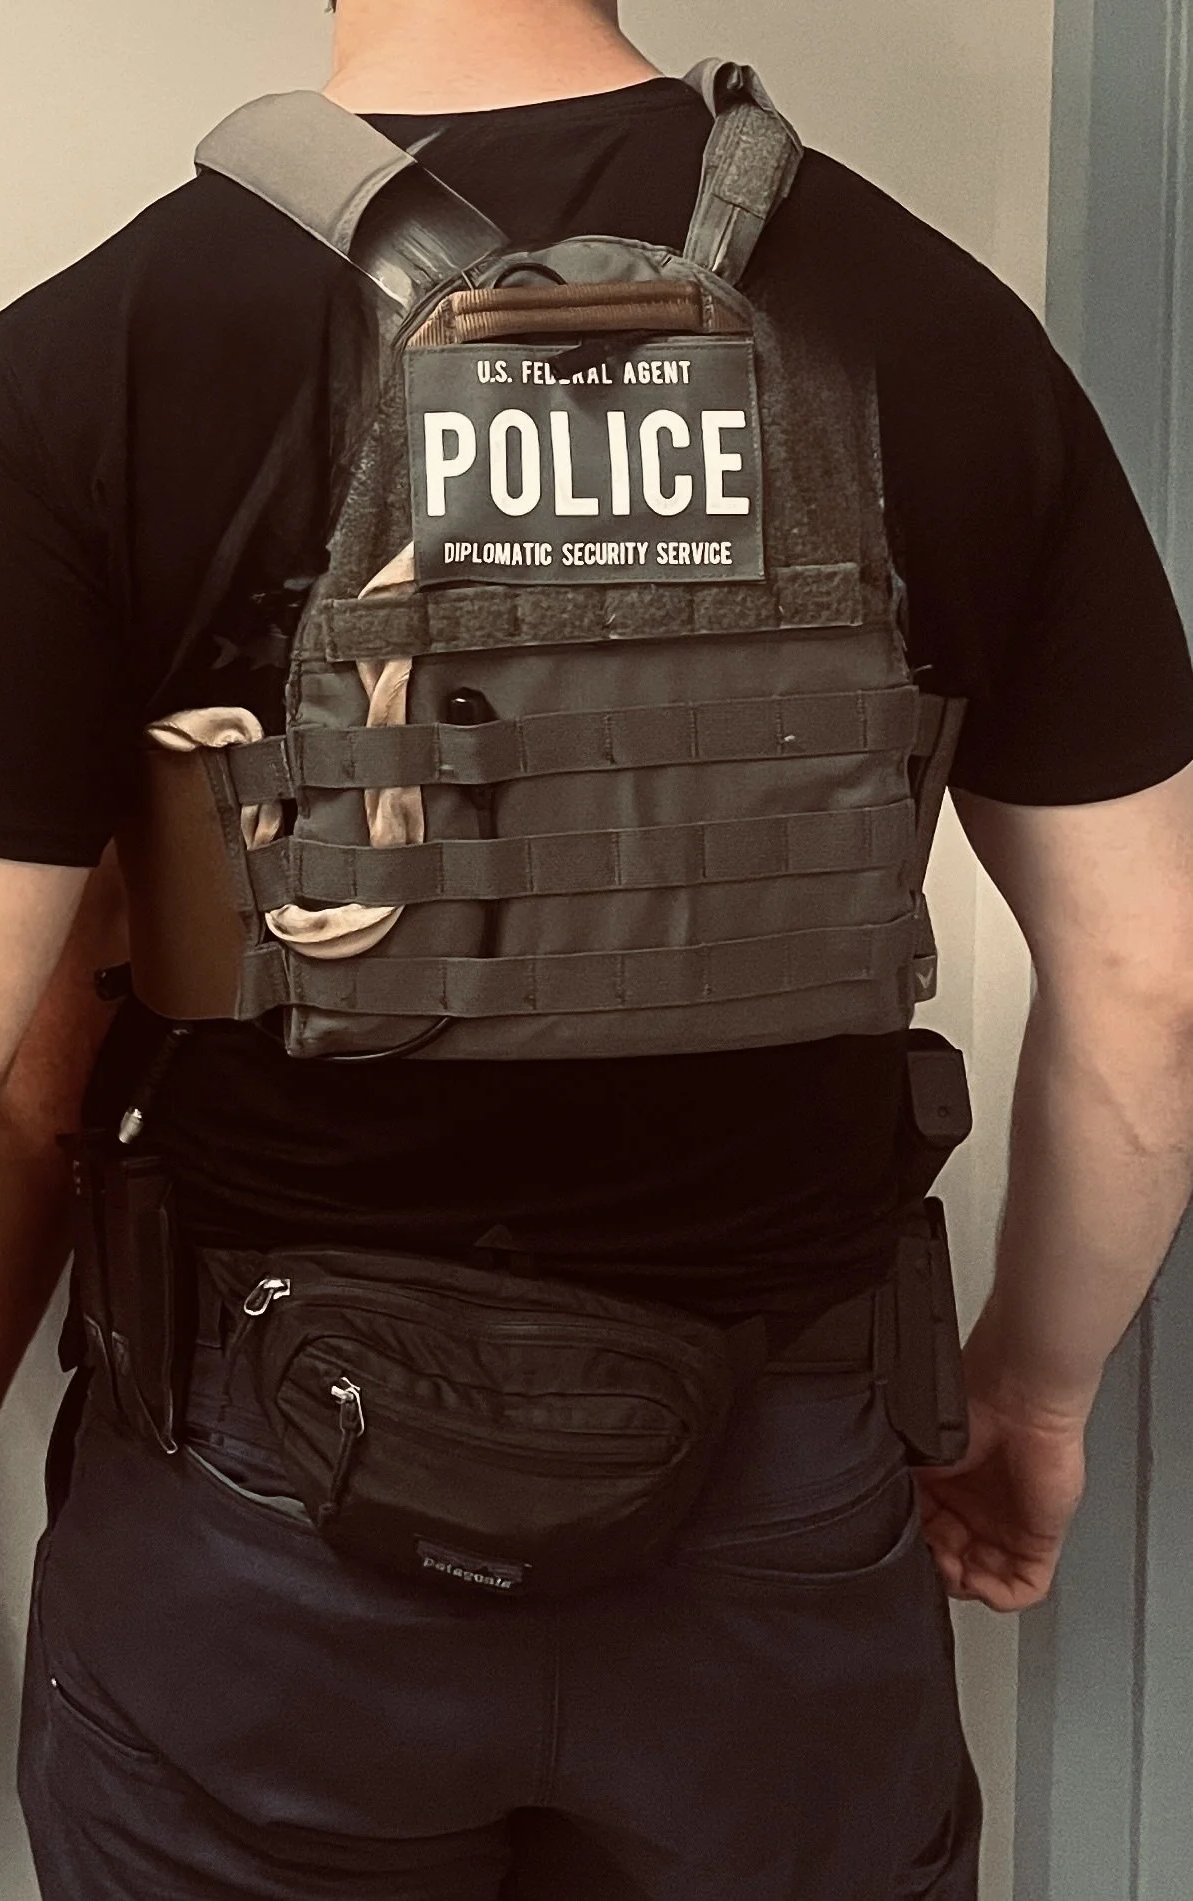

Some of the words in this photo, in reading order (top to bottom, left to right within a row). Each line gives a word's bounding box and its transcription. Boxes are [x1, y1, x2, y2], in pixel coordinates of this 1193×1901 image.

[477, 360, 513, 384] U.S.
[623, 360, 691, 385] AGENT
[423, 408, 750, 517] POLICE
[444, 542, 553, 566] DIPLOMATIC
[561, 541, 649, 566] SECURITY
[656, 541, 733, 565] SERVICE
